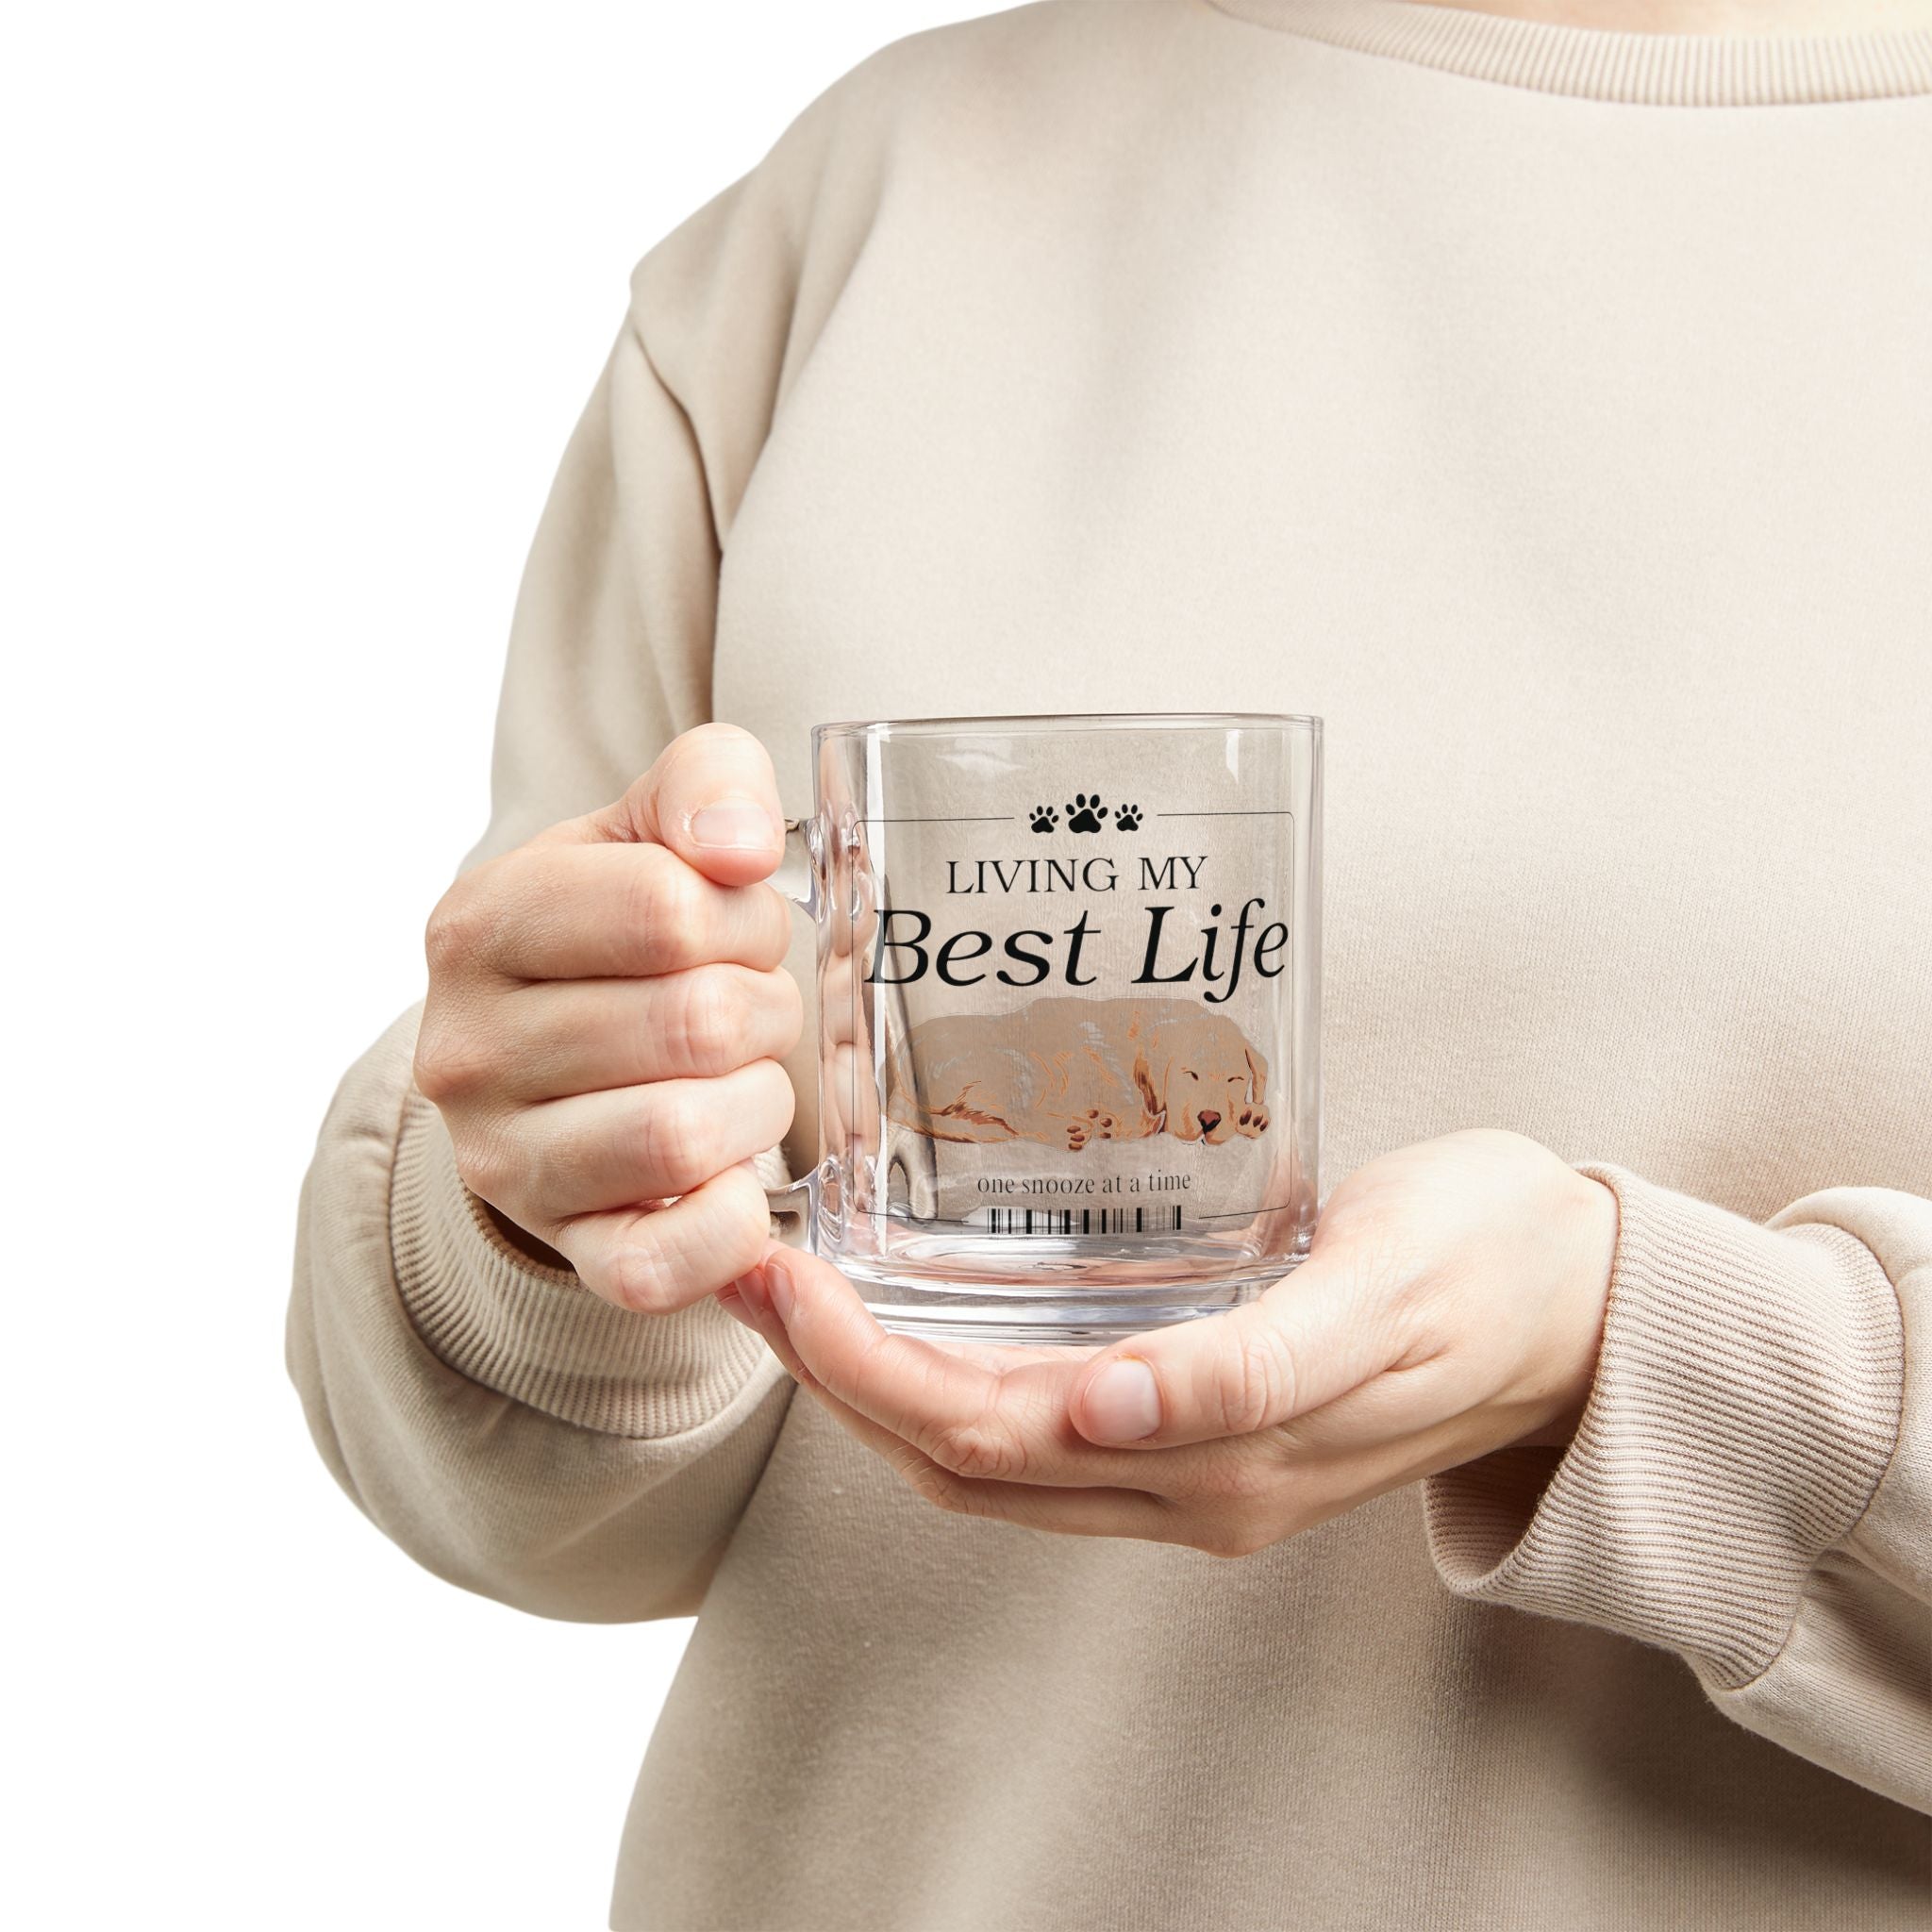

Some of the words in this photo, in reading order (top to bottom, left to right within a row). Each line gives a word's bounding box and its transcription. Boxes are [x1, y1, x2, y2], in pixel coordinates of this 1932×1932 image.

[945, 858, 1120, 894] LIVING
[1137, 856, 1208, 891] MY
[864, 908, 1102, 987] Best
[1130, 897, 1289, 1004] Life
[977, 1176, 1015, 1193] one
[1022, 1177, 1095, 1194] snooze
[1102, 1174, 1123, 1193] at
[1129, 1177, 1140, 1192] a
[1148, 1169, 1191, 1191] time
